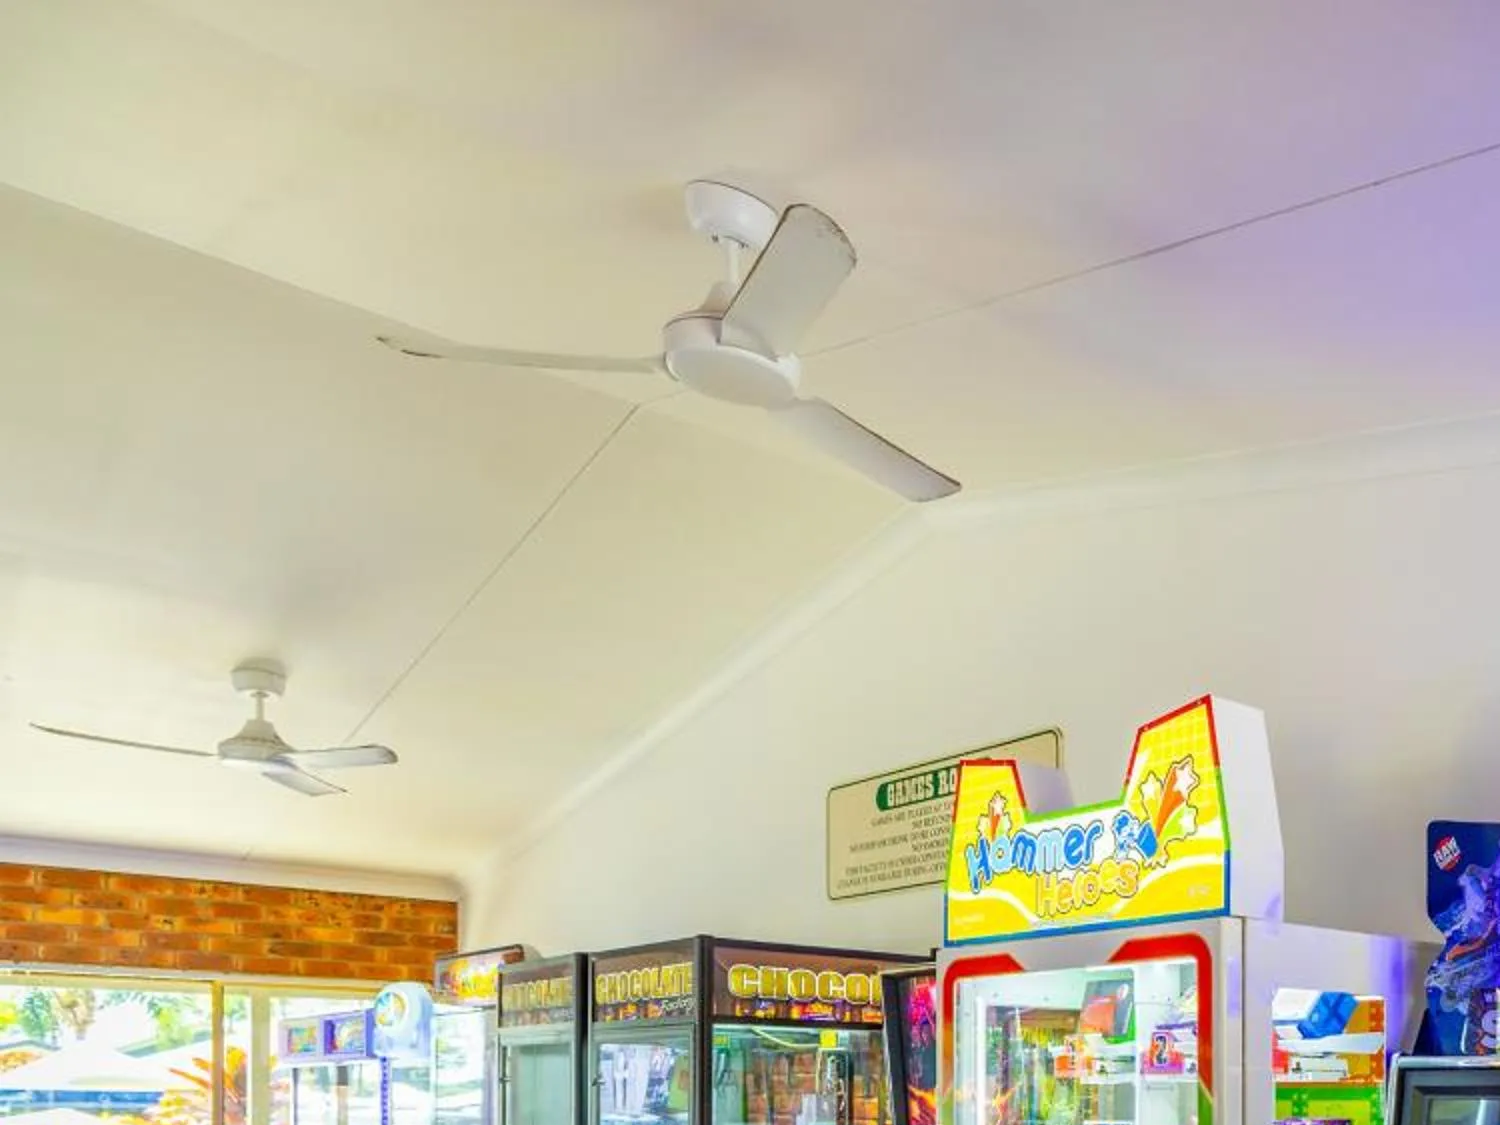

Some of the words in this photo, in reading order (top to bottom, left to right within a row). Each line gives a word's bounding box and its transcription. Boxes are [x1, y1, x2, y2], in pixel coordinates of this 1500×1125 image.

[965, 819, 1104, 894] Hammer
[1035, 857, 1140, 918] Heroes
[595, 961, 696, 1005] CHOCOLATE
[1155, 1034, 1168, 1065] 2
